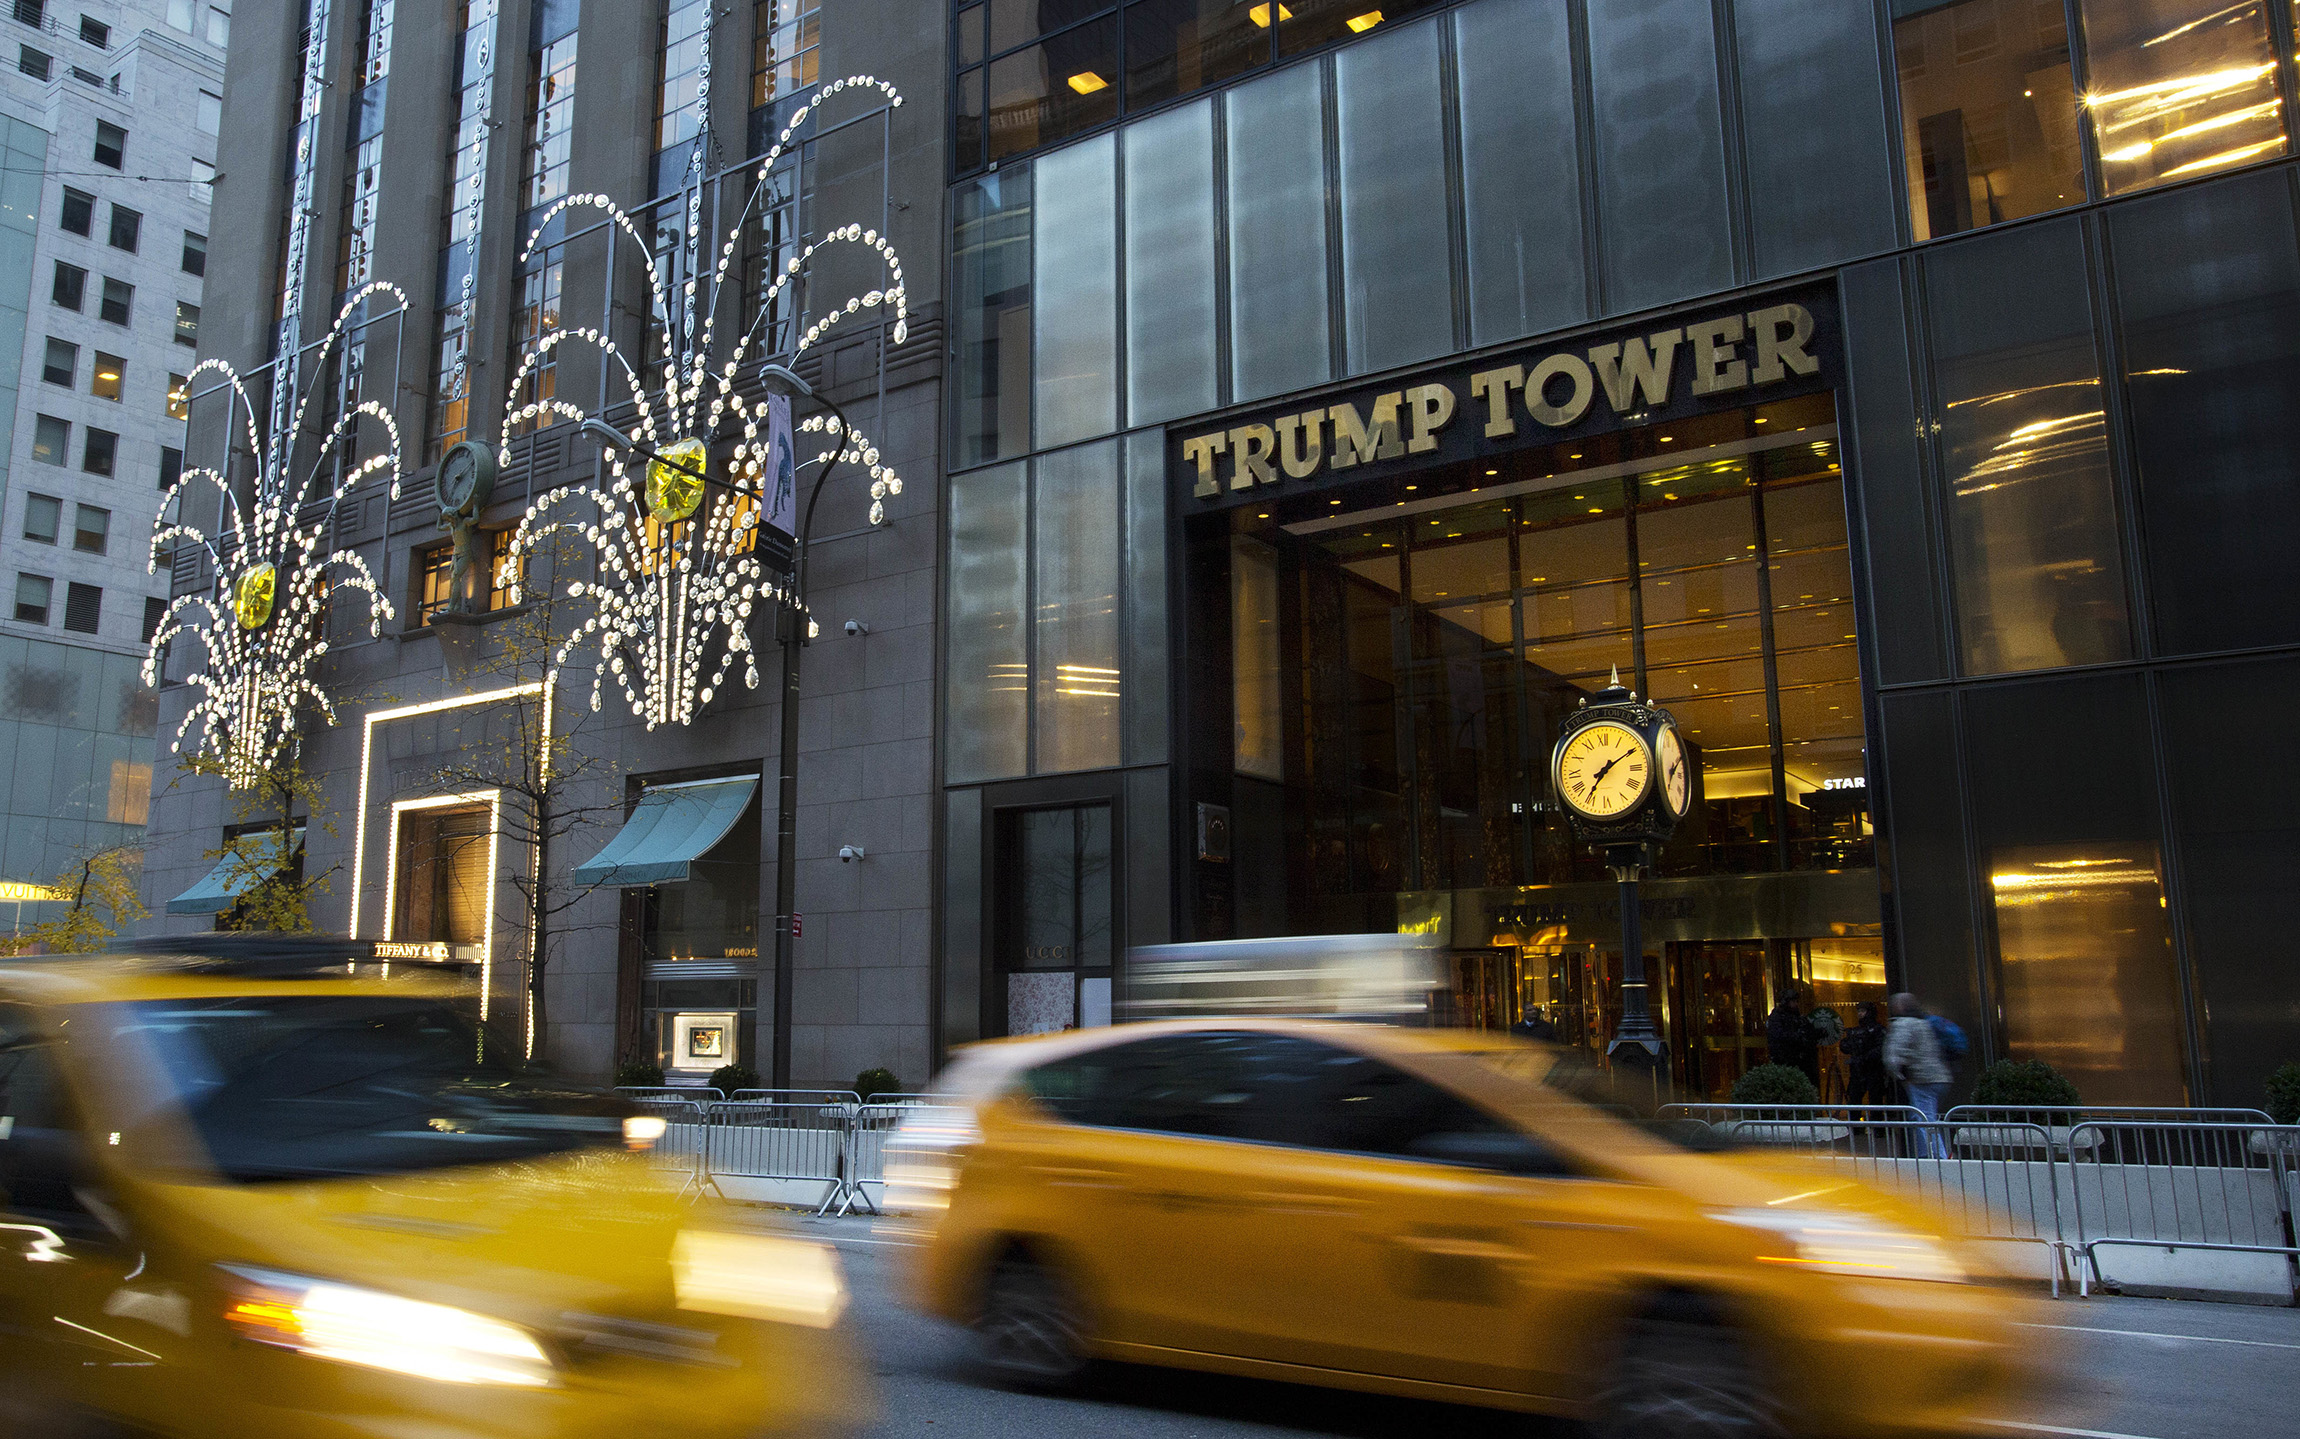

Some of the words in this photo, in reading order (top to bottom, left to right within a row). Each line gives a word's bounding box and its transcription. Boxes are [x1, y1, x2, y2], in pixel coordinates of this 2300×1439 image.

[1183, 383, 1457, 498] TRUMP
[1470, 302, 1820, 439] TOWER
[1570, 710, 1599, 728] TRUMP
[1603, 709, 1633, 722] TOWER
[1823, 776, 1866, 791] STAR
[374, 944, 421, 957] TIFFANY
[422, 945, 431, 957] &
